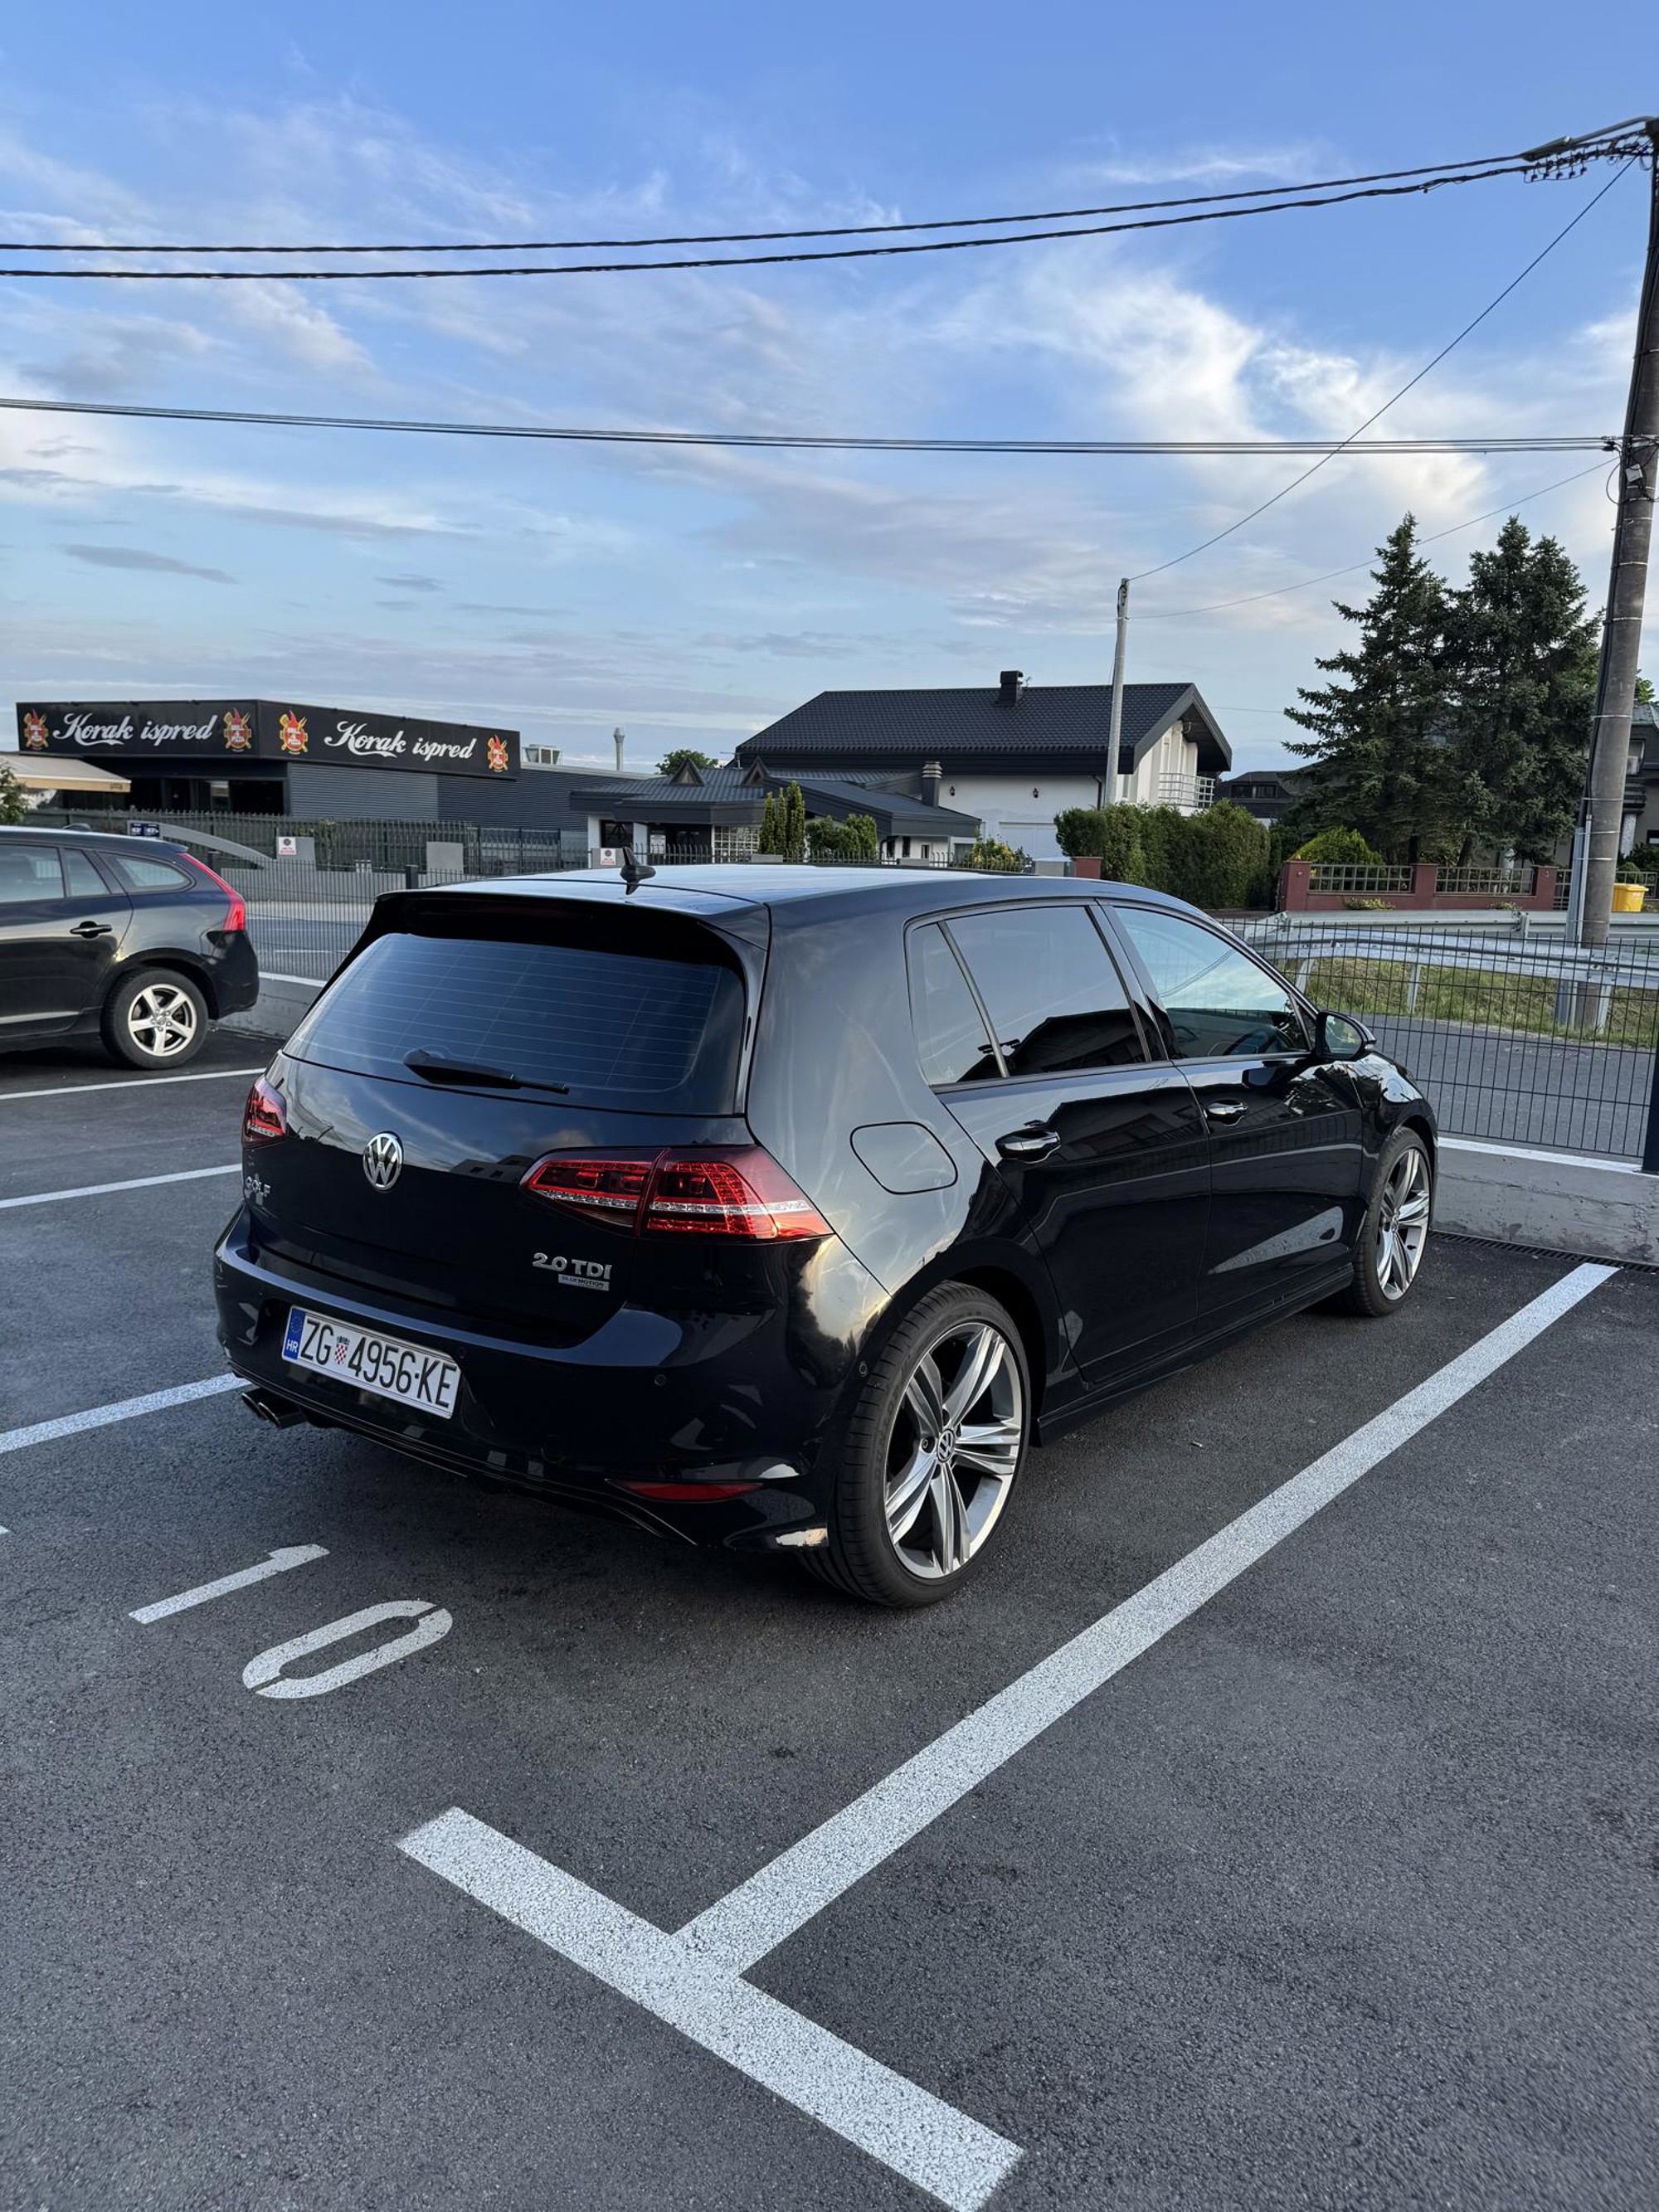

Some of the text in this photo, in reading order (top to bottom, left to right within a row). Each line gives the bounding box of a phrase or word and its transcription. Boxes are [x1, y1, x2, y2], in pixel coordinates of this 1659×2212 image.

[52, 712, 134, 746] Korak
[140, 715, 218, 746] ispred
[324, 721, 407, 758] Korak
[412, 737, 477, 761] ispred
[362, 1133, 402, 1191] VW
[572, 1259, 612, 1280] TDI
[285, 1339, 299, 1353] HR
[300, 1318, 334, 1365] ZG
